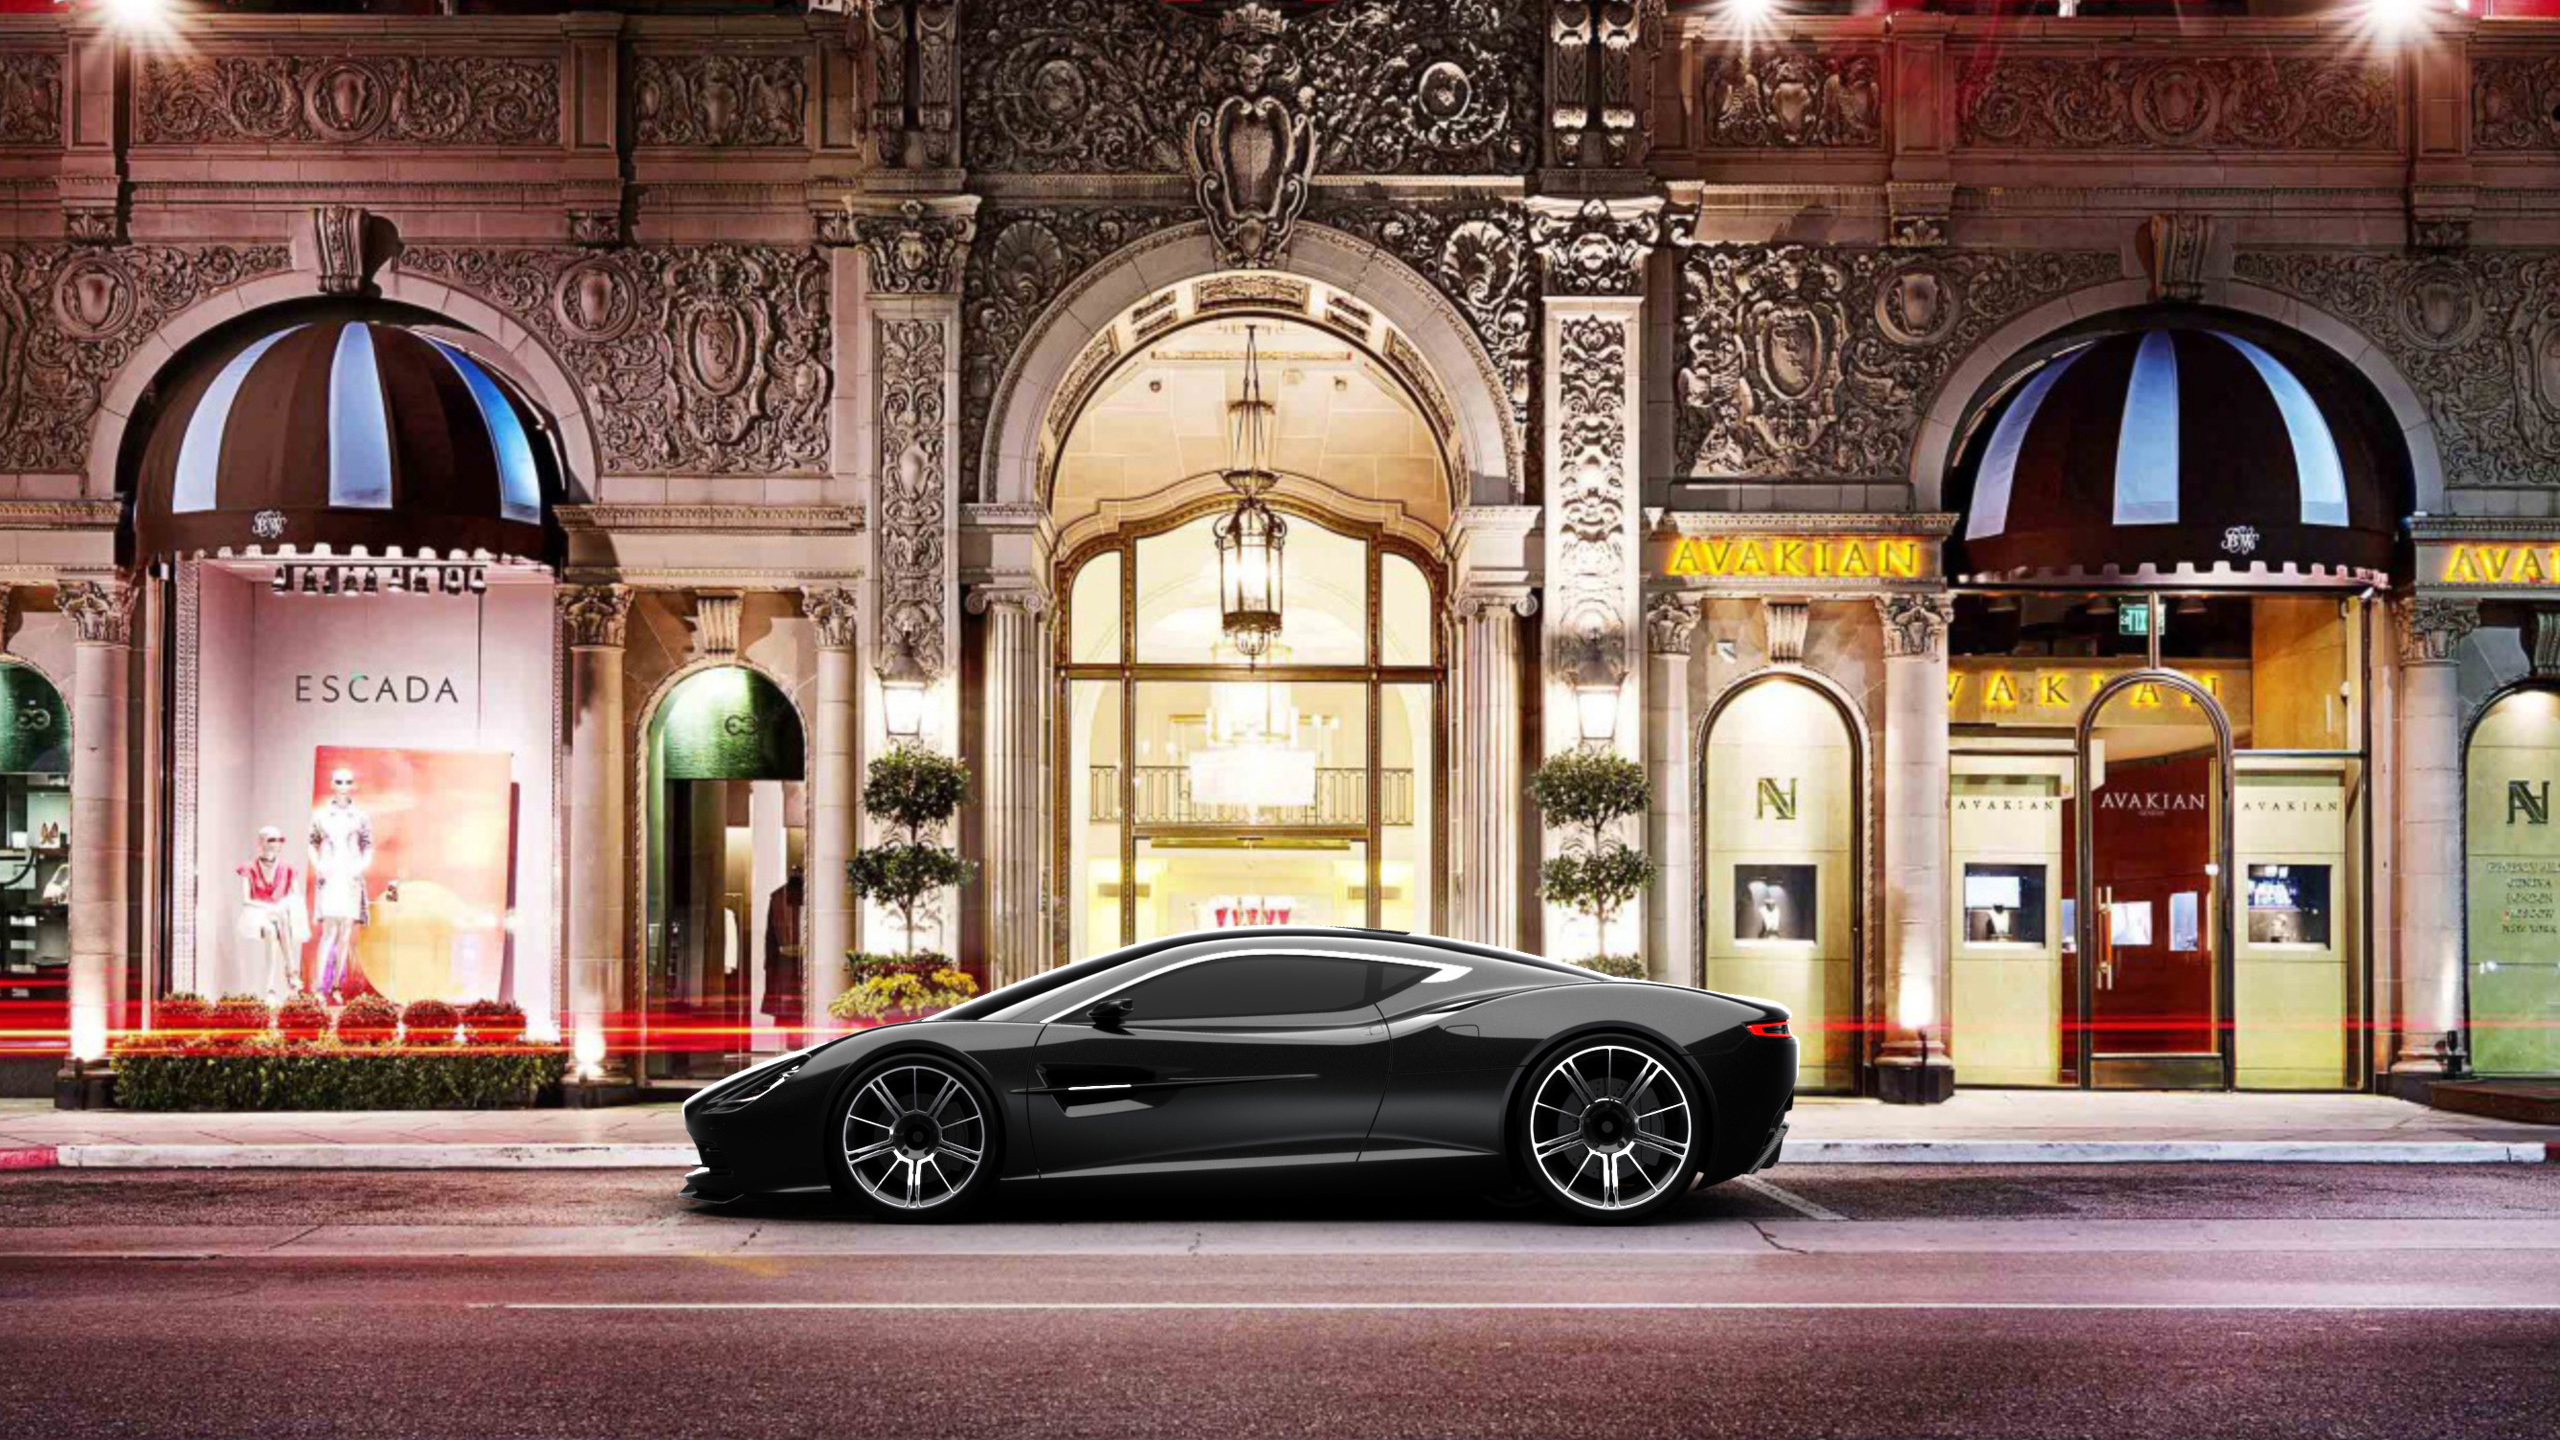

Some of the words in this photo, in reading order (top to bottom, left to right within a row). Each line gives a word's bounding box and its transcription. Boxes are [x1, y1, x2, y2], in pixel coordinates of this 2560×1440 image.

[1672, 540, 1918, 574] AVAKIAN
[2443, 546, 2560, 582] AVA
[295, 674, 459, 703] ESCADA
[1958, 799, 2053, 810] AVAKIAN
[2100, 792, 2205, 810] AVAKIAN
[2242, 801, 2338, 812] AVAKIAN
